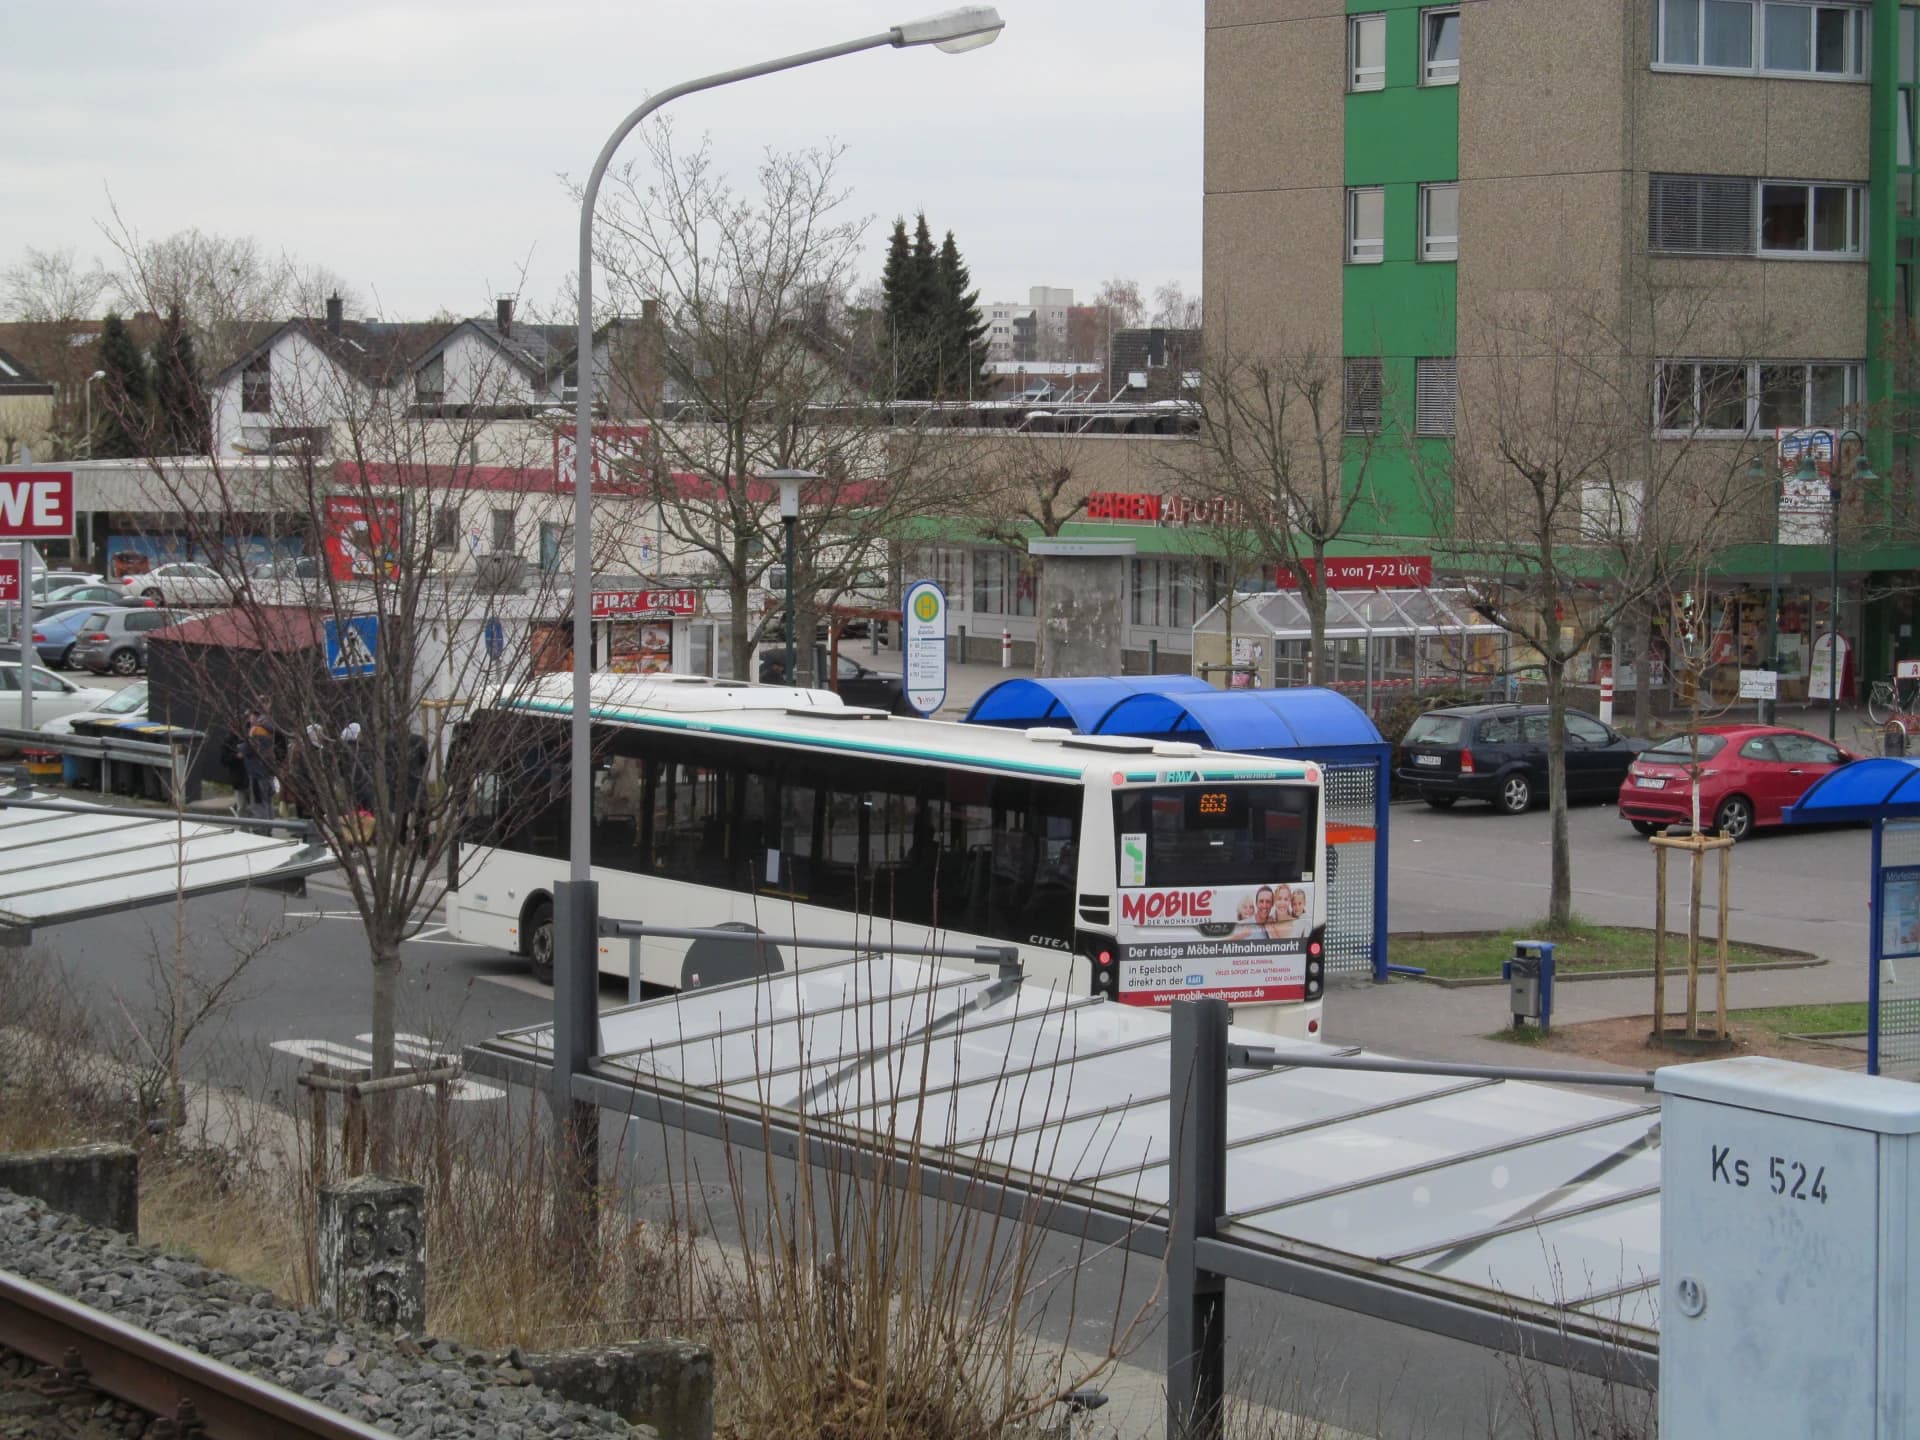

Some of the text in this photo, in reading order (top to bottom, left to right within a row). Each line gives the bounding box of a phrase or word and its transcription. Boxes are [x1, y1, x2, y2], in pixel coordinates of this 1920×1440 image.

[1341, 566, 1364, 577] von
[1200, 793, 1227, 812] 663
[1122, 890, 1213, 925] MOBILE
[1129, 941, 1299, 958] Der riesige Möbel-Mitnahmemarkt
[1129, 964, 1182, 977] in Egelsbach
[1128, 979, 1152, 987] direkt
[1170, 976, 1183, 985] der
[1711, 1144, 1828, 1205] Ks 524
